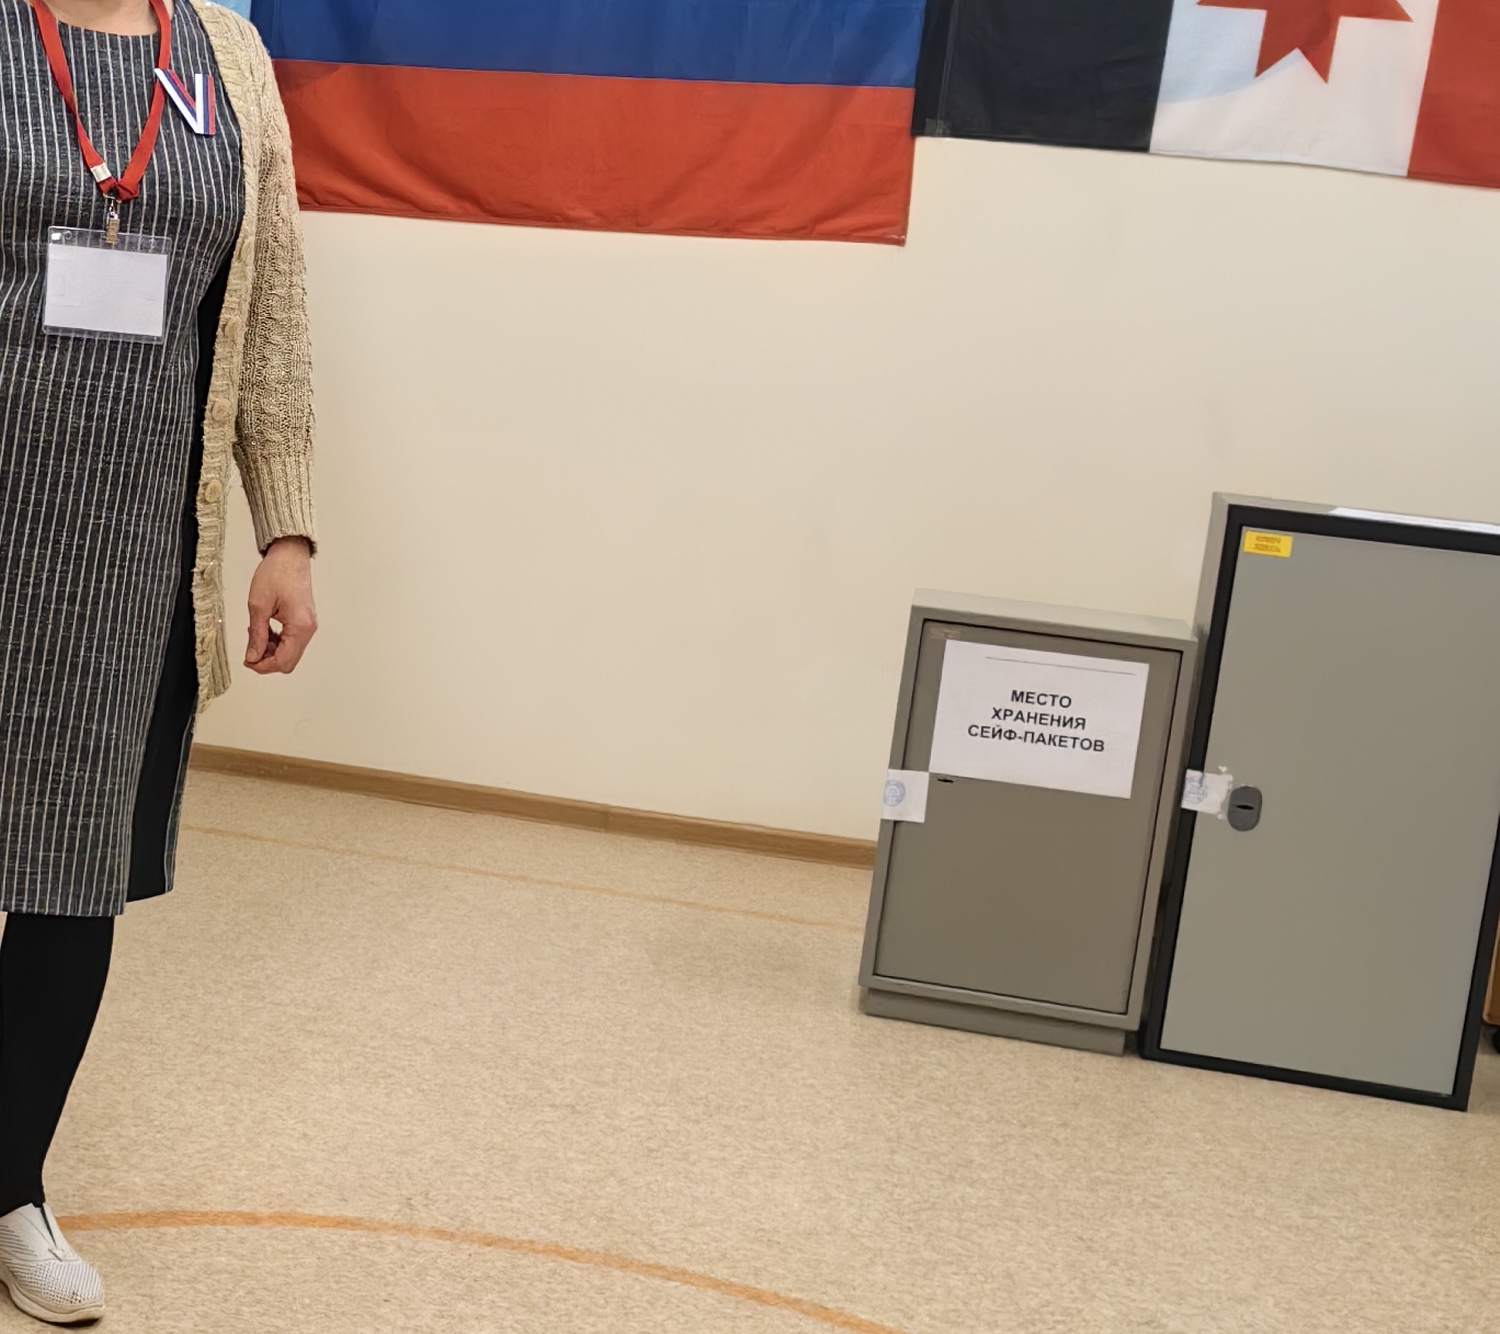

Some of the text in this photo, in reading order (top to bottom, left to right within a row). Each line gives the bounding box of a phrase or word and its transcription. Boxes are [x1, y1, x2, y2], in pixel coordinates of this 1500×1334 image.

[1010, 689, 1073, 710] МЕСТО
[990, 706, 1087, 731] ХРАНЕНИЯ
[967, 723, 1106, 753] СЕЙФ-ПАКЕТОВ
